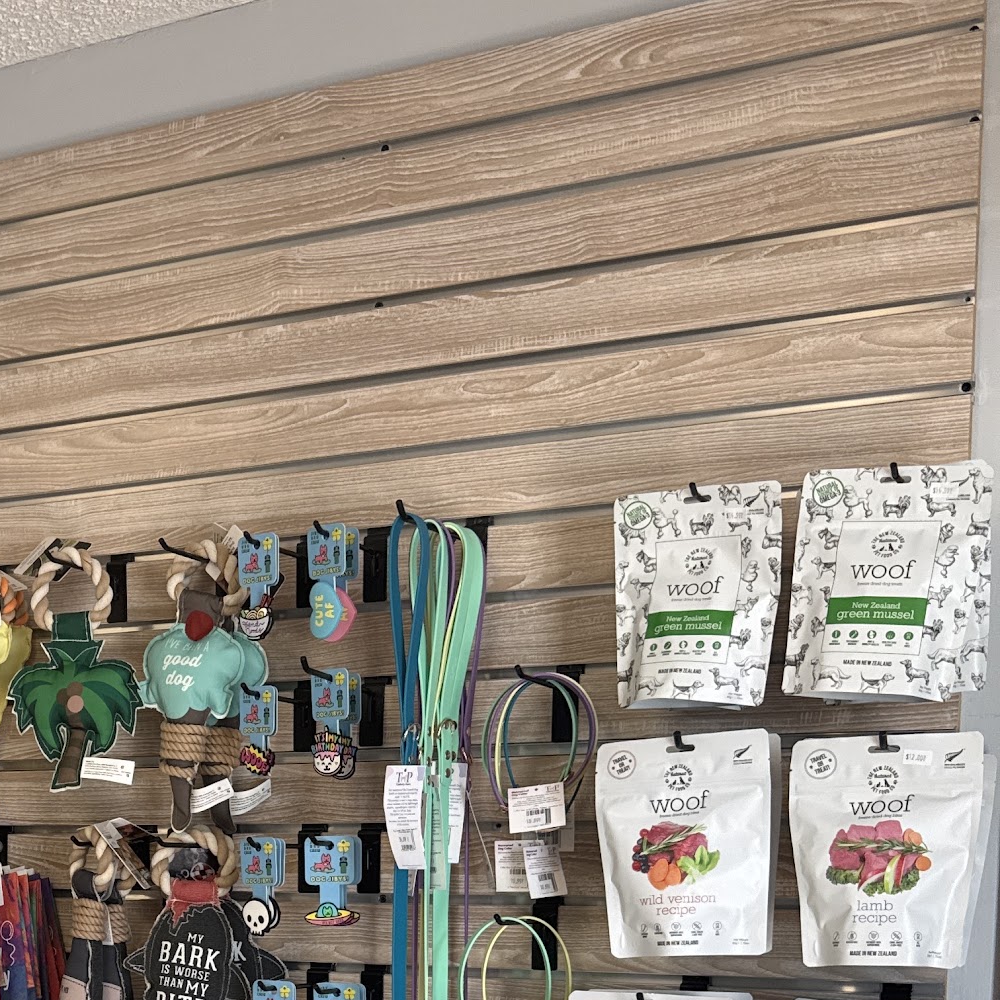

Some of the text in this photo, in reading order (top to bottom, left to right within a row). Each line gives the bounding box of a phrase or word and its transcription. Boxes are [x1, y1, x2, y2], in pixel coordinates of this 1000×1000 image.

[851, 559, 917, 580] woof
[667, 576, 725, 597] woof
[314, 594, 324, 628] CUTE
[324, 603, 335, 625] AF
[683, 614, 710, 622] Zealand
[654, 621, 722, 634] green mussel
[203, 641, 209, 652] A
[162, 653, 203, 670] good
[165, 670, 195, 691] dog
[311, 743, 344, 755] BIRTHDAY
[810, 753, 828, 764] TRAVEL
[650, 790, 710, 815] woof
[849, 794, 915, 816] woof
[639, 893, 716, 906] wild venison
[857, 900, 893, 912] lamb
[656, 905, 697, 917] recipe
[852, 912, 897, 926] recipe
[187, 932, 204, 944] MY
[158, 940, 220, 972] BARK
[161, 964, 211, 982] IS WORSE
[159, 976, 209, 997] THAN MY
